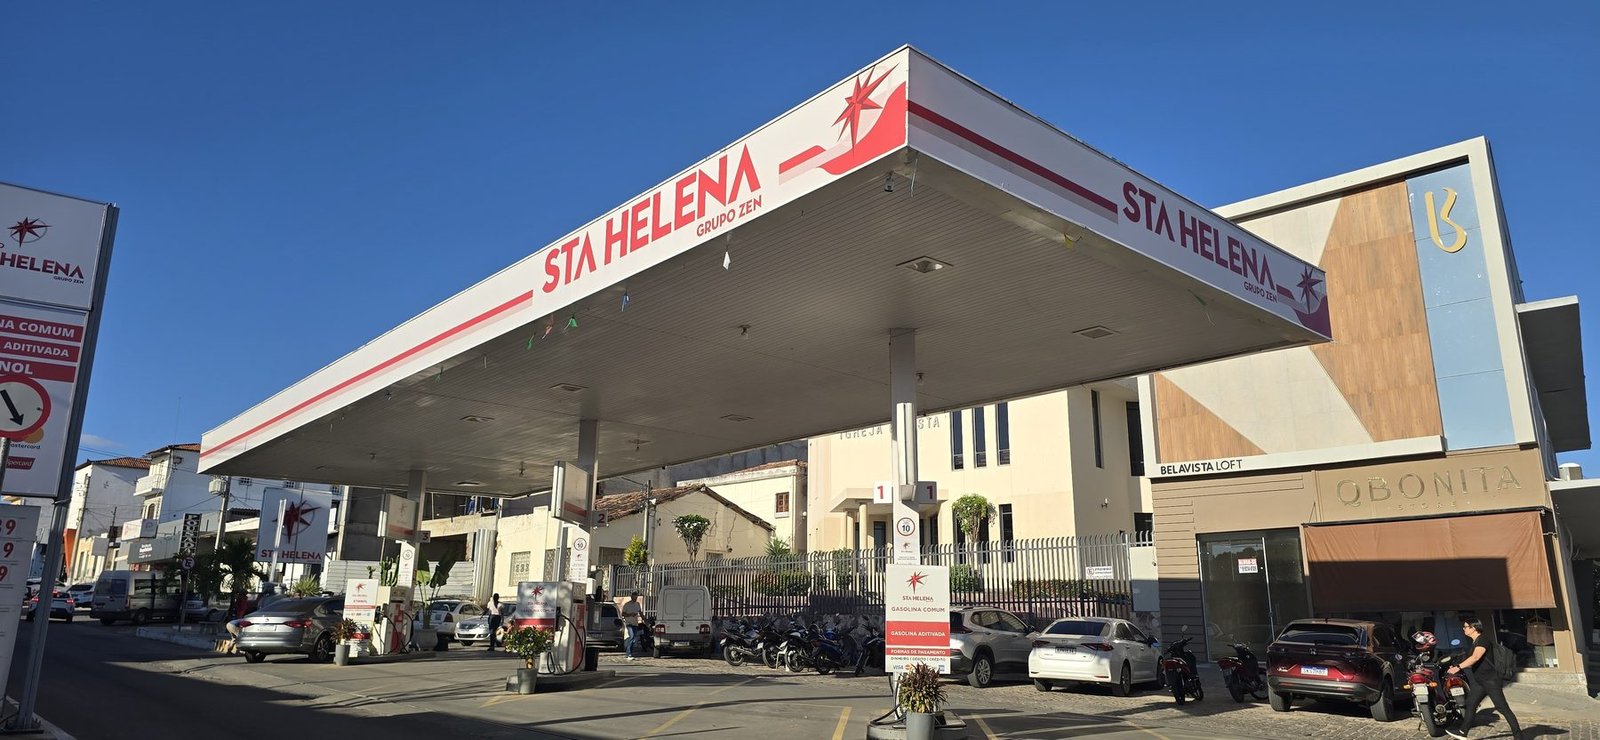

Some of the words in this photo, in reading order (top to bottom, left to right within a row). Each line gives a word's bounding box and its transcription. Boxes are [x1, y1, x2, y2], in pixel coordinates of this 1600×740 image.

[542, 231, 597, 293] STA
[604, 143, 761, 265] HELENA
[696, 209, 735, 237] GRUPO
[739, 195, 762, 218] ZEN
[1123, 181, 1175, 242] STA
[1179, 210, 1275, 290] HELENA
[0, 252, 84, 279] HELENA
[1244, 281, 1264, 297] GRUPO
[1266, 290, 1277, 303] ZEN
[19, 322, 74, 338] COMUM
[4, 341, 69, 357] ADITIVADA
[1160, 462, 1213, 475] BELAVISTA
[1215, 459, 1242, 471] LOFT
[877, 485, 884, 499] 1
[926, 485, 933, 499] 1
[1336, 465, 1522, 508] QBONITA
[597, 513, 605, 523] 2
[422, 532, 429, 540] 3
[902, 524, 911, 532] 10
[261, 550, 280, 558] ST
[282, 550, 321, 559] HELENA
